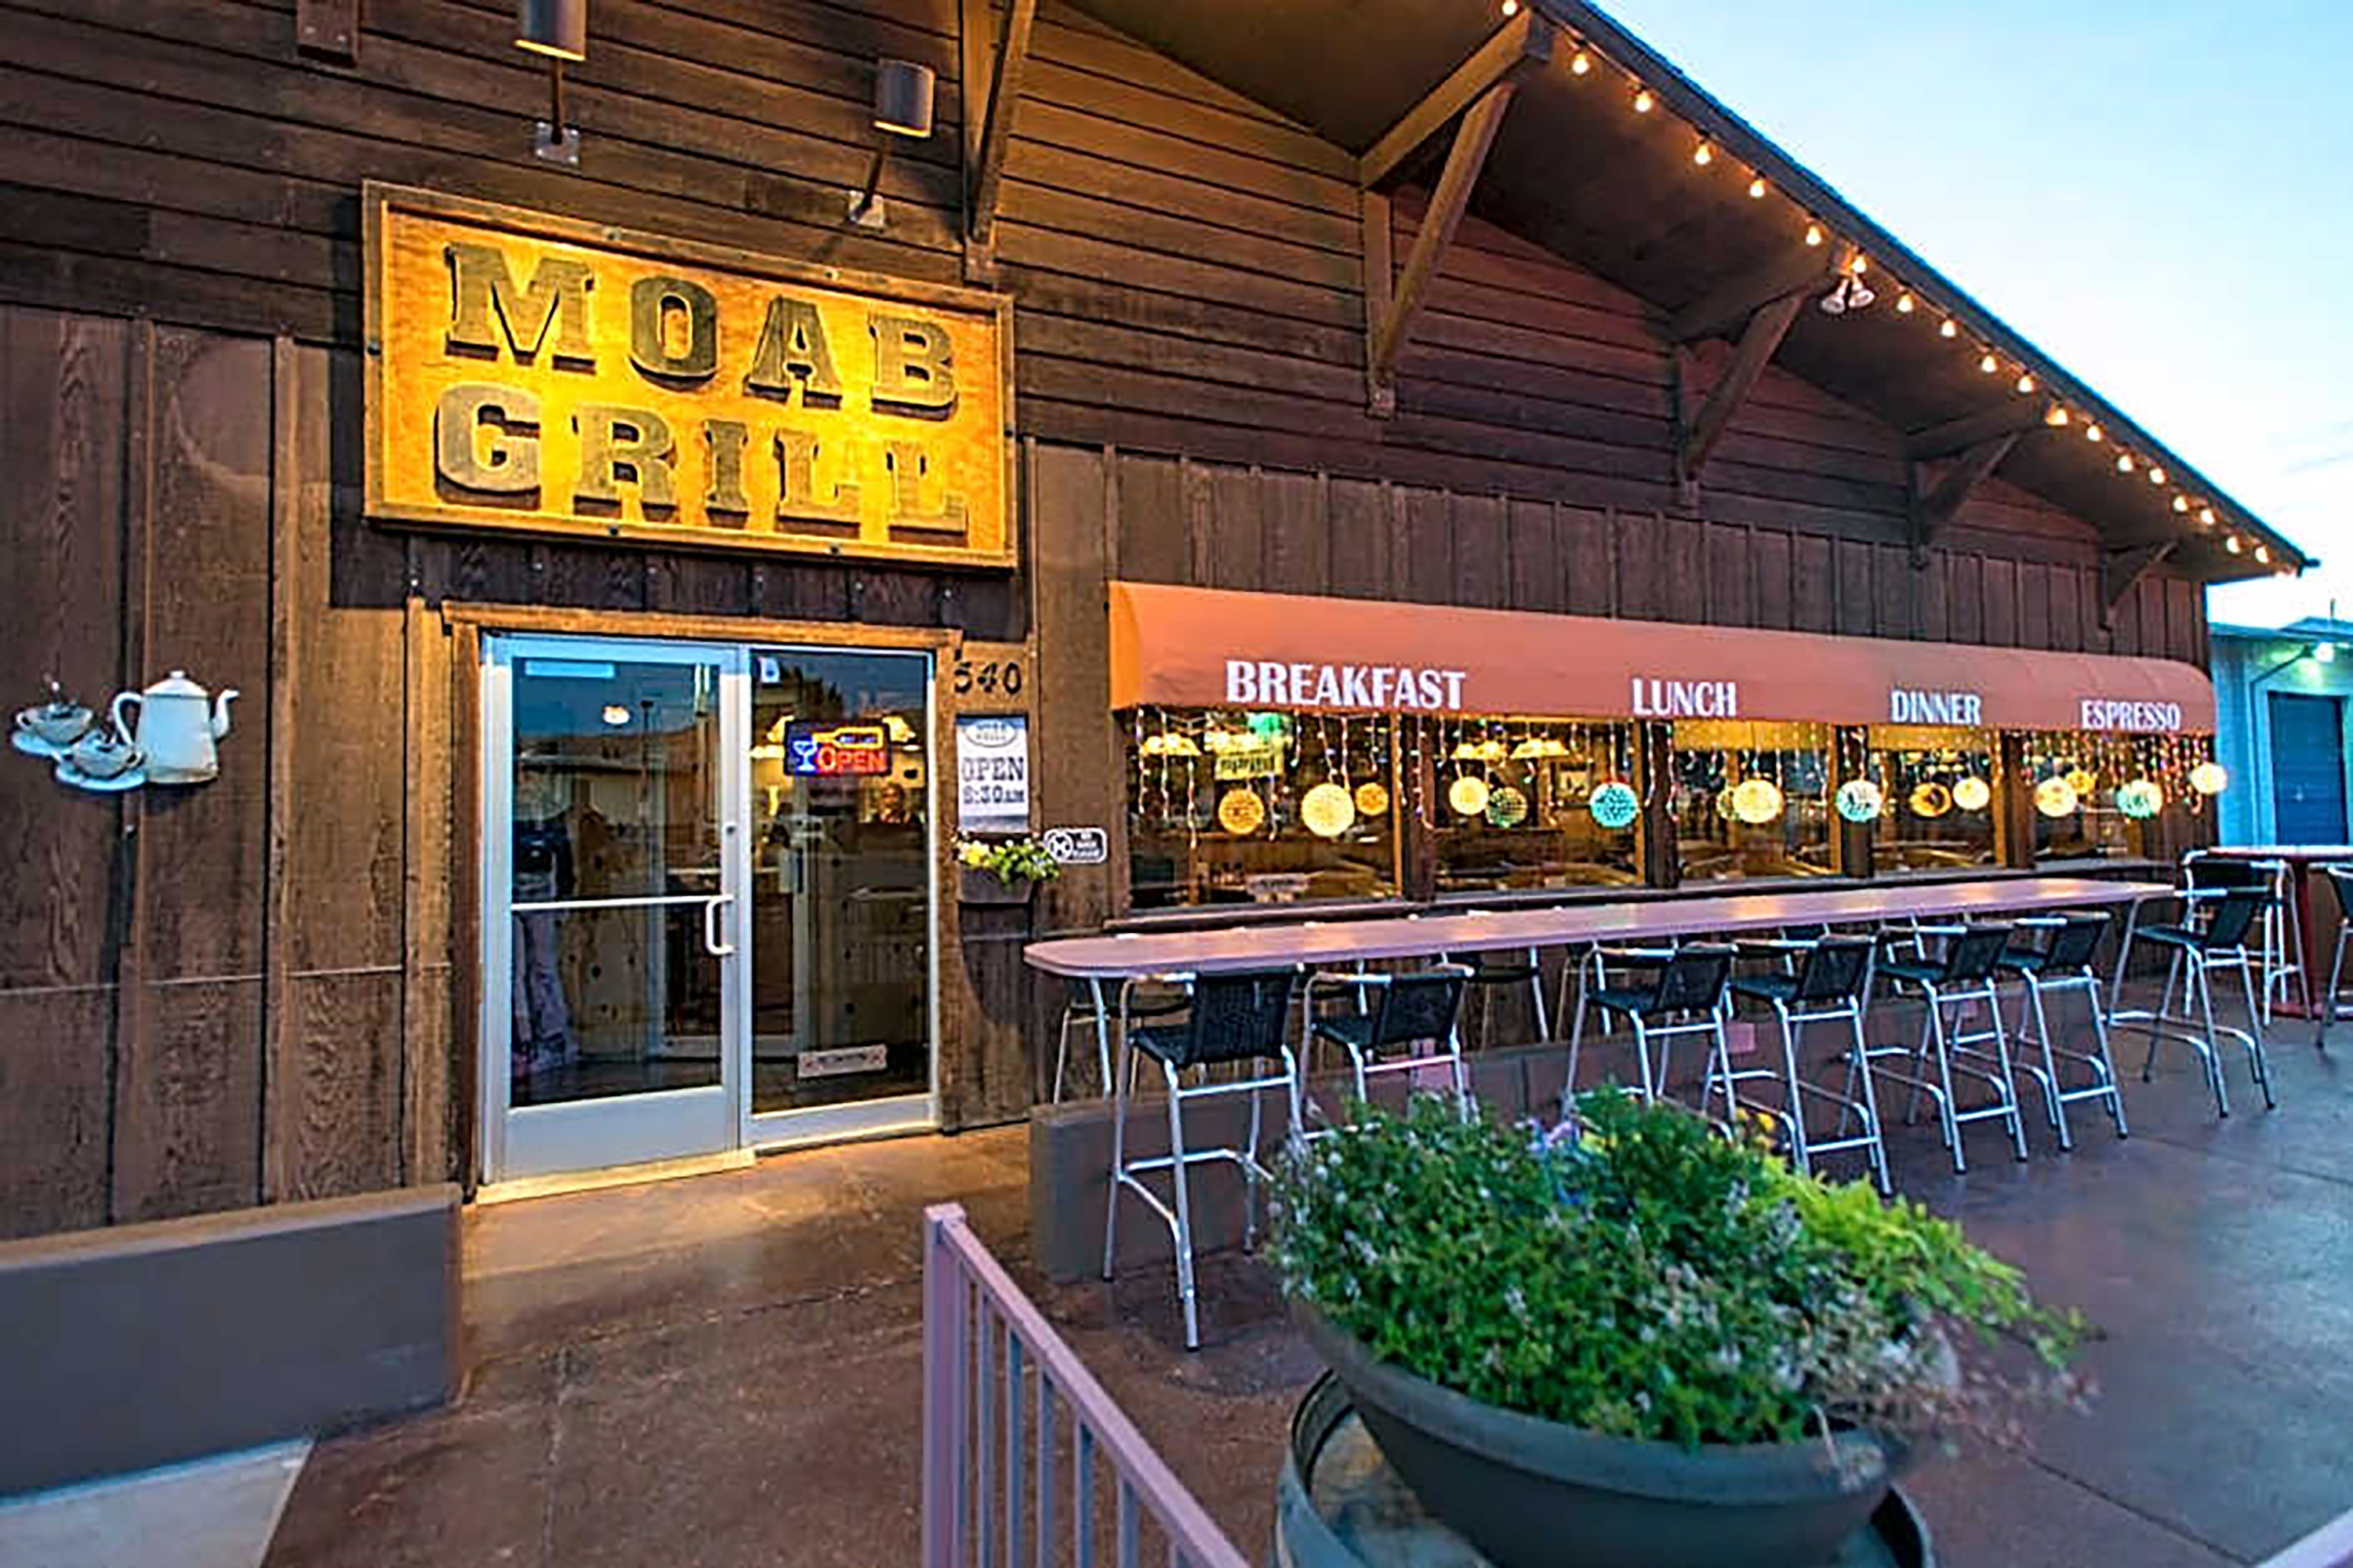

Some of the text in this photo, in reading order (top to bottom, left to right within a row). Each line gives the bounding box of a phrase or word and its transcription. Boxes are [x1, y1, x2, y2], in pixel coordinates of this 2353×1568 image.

[444, 241, 959, 421] MOAB
[434, 383, 968, 539] GRILL
[953, 662, 1022, 695] 540
[1225, 659, 1465, 710] BREAKFAST
[1632, 677, 1738, 717] LUNCH
[1891, 690, 1982, 726] DINNER
[2081, 699, 2181, 731] ESPRESSO
[818, 745, 886, 772] OPEN
[961, 755, 1024, 782] OPEN
